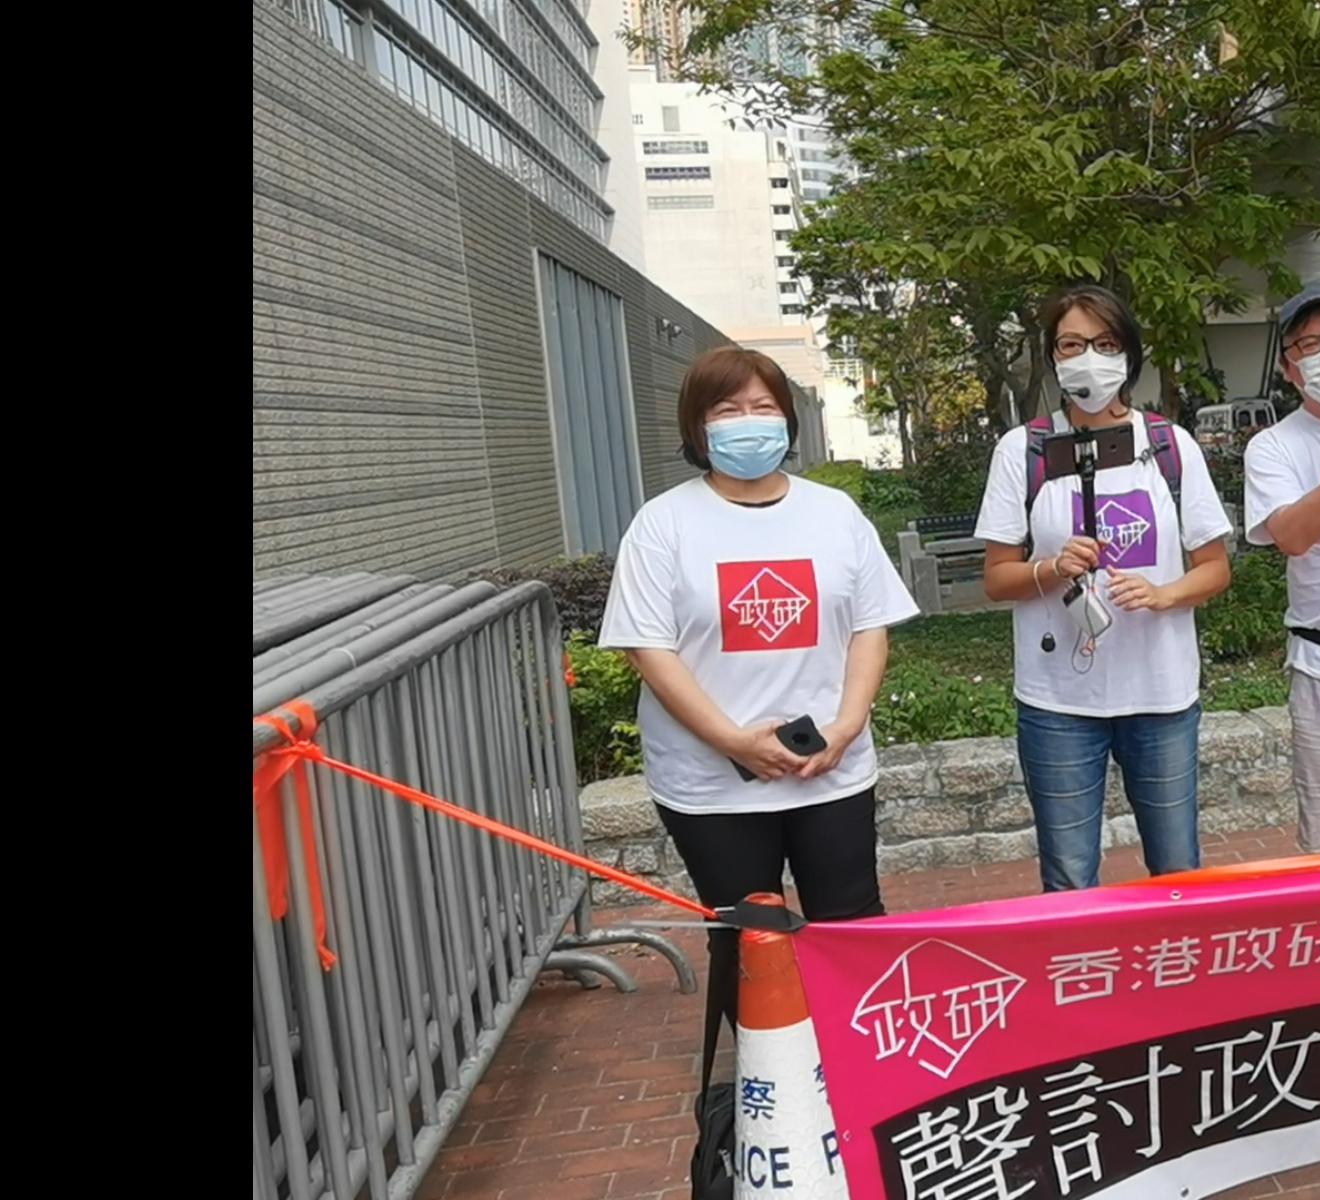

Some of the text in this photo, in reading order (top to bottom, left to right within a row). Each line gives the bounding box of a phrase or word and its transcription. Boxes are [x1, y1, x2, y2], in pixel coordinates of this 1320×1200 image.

[729, 581, 810, 632] 政研
[853, 955, 1027, 1060] 政研
[741, 1077, 776, 1120] 察
[736, 1141, 793, 1189] ICE
